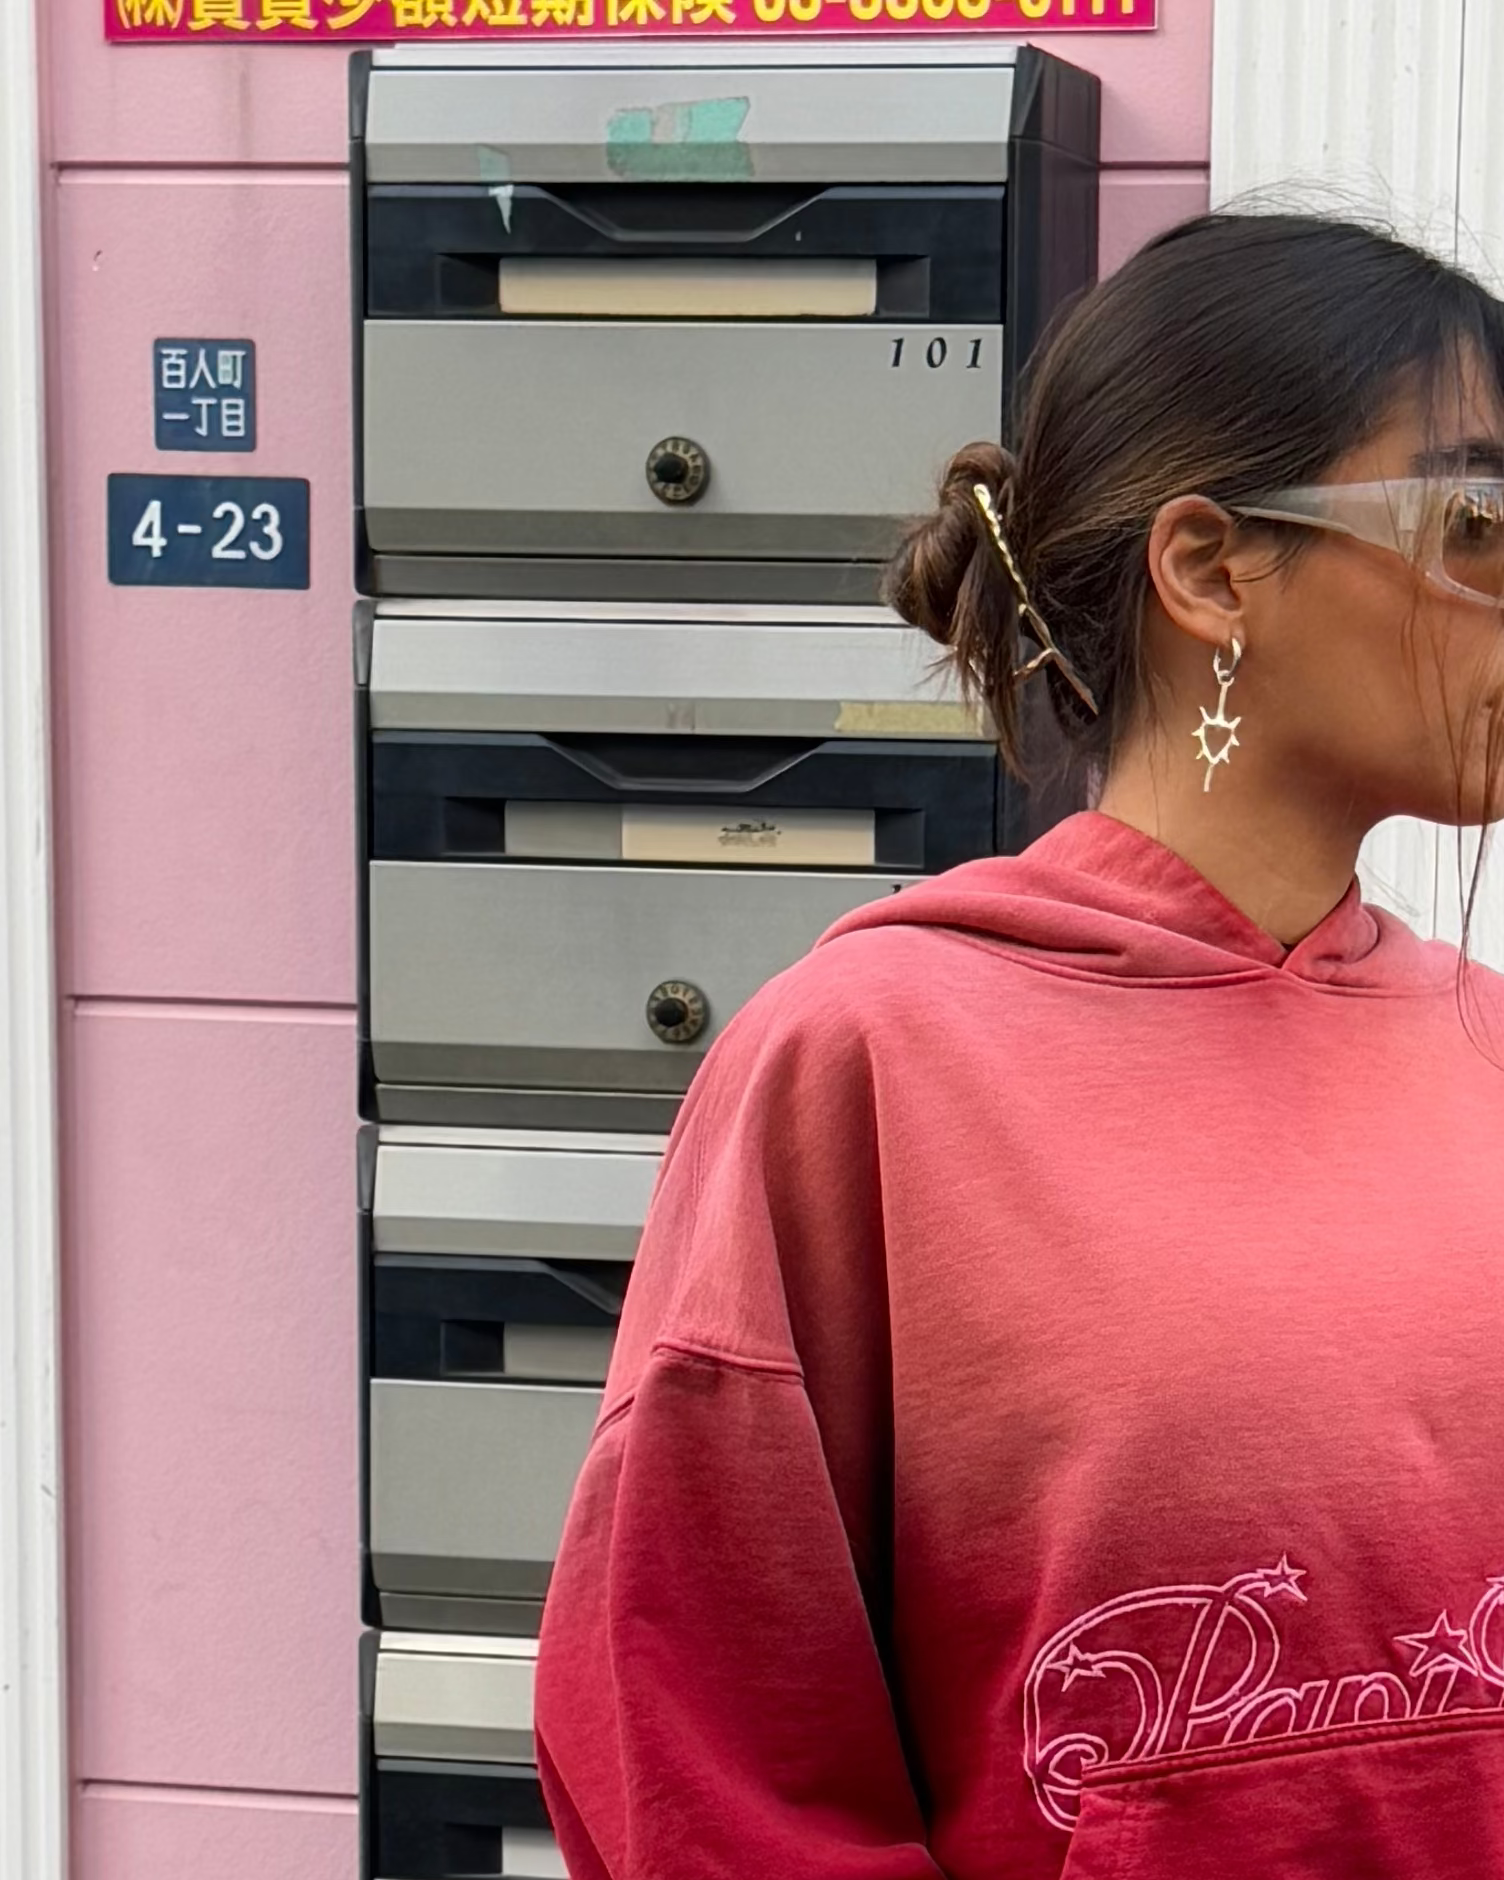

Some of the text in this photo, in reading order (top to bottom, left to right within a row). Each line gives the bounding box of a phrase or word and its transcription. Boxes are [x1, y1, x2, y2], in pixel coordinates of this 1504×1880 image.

[160, 347, 247, 389] 百人町
[890, 336, 983, 369] 101
[161, 397, 246, 437] 一丁目
[131, 500, 283, 560] 4-23
